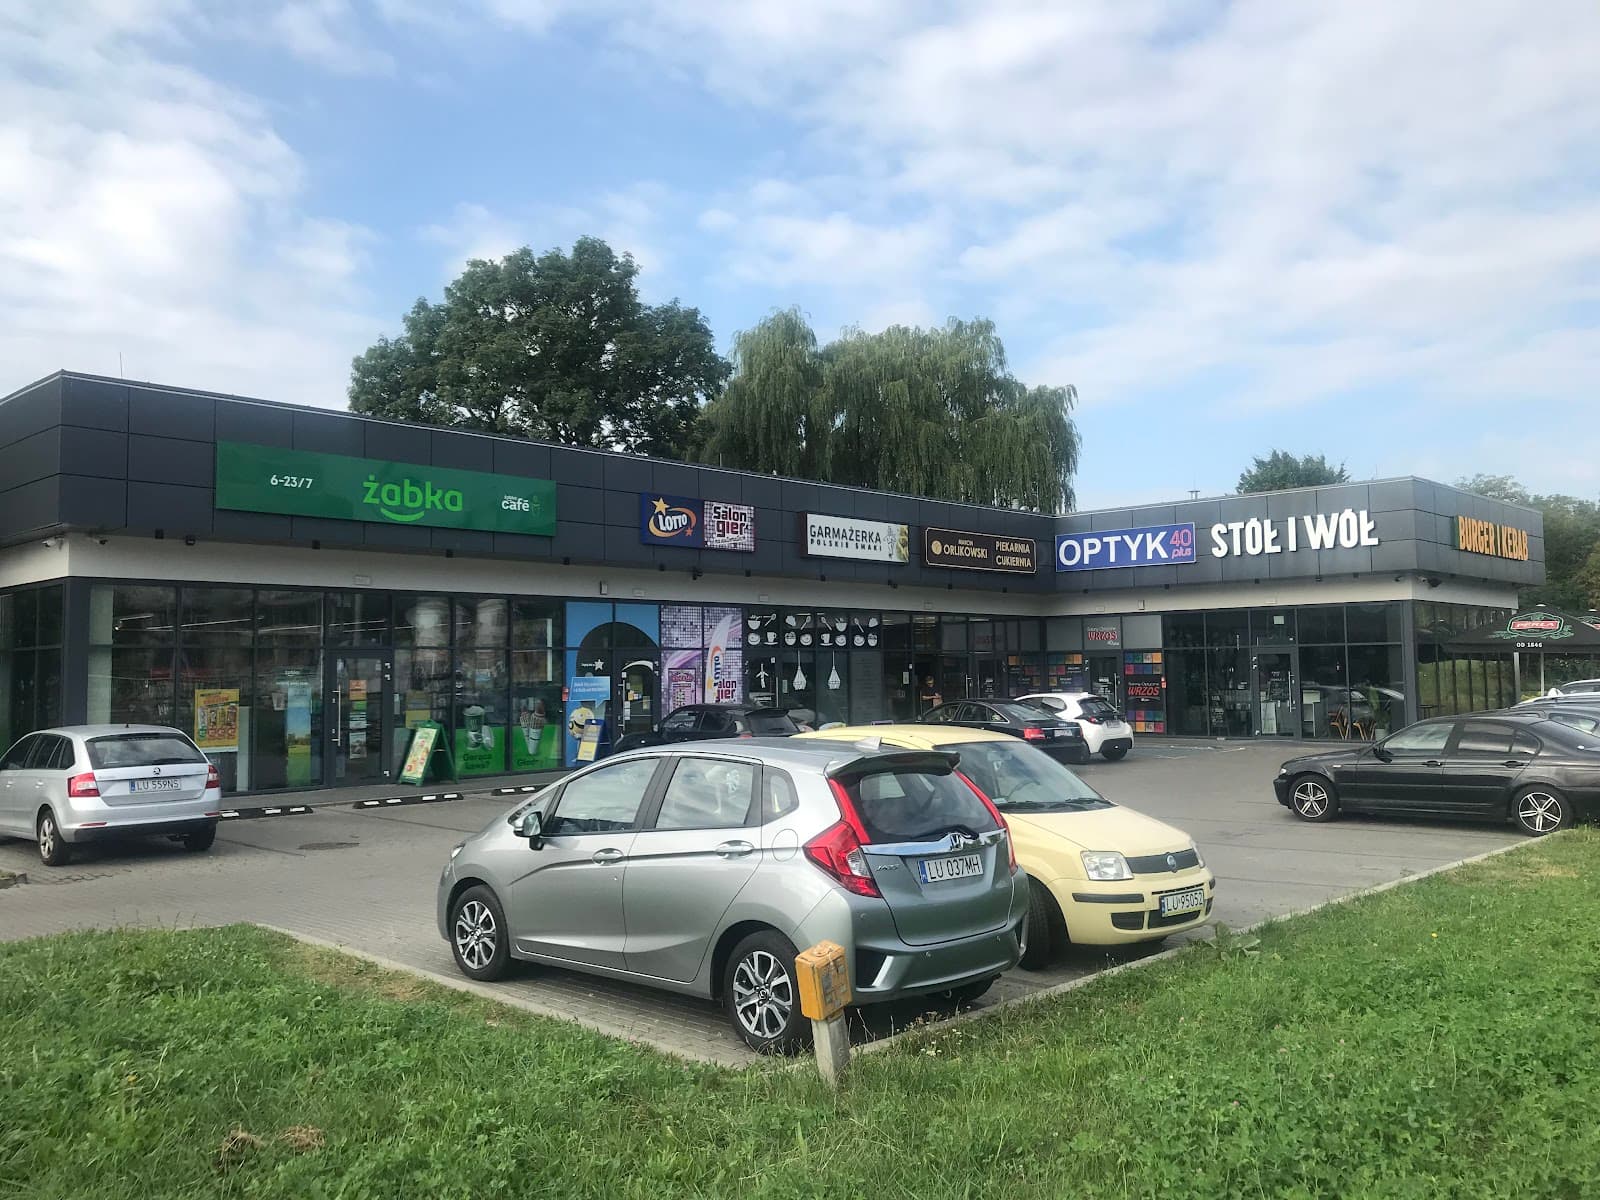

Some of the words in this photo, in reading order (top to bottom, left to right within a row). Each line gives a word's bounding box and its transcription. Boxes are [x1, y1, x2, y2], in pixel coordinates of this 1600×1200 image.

[270, 474, 313, 489] 6-23/7
[362, 474, 464, 512] żabka
[658, 513, 688, 531] LOTTO
[713, 505, 747, 522] Salon
[717, 520, 746, 538] gier
[809, 524, 882, 545] GARMAŻERKA
[1211, 517, 1281, 558] STÓŁ
[1288, 516, 1297, 551] I
[1303, 508, 1379, 550] WÓŁ
[1458, 515, 1496, 556] BURGER
[1497, 524, 1501, 556] I
[1502, 525, 1529, 560] KEBAB
[810, 538, 849, 549] POLSKIE
[855, 542, 882, 551] SMAKI
[1170, 529, 1192, 547] 40
[943, 544, 988, 559] ORLIKOWSKI
[995, 541, 1031, 554] PIEKARNIA
[1059, 531, 1168, 566] OPTYK
[1171, 546, 1192, 559] plus
[995, 555, 1032, 568] CUKIERNIA
[1087, 630, 1118, 641] WRZOS
[717, 678, 737, 689] alon
[1127, 686, 1161, 696] WRZOS
[136, 779, 149, 791] LU
[927, 861, 943, 879] LU
[946, 856, 981, 877] 037MH
[1166, 896, 1179, 911] LU
[1181, 892, 1203, 909] 95052
